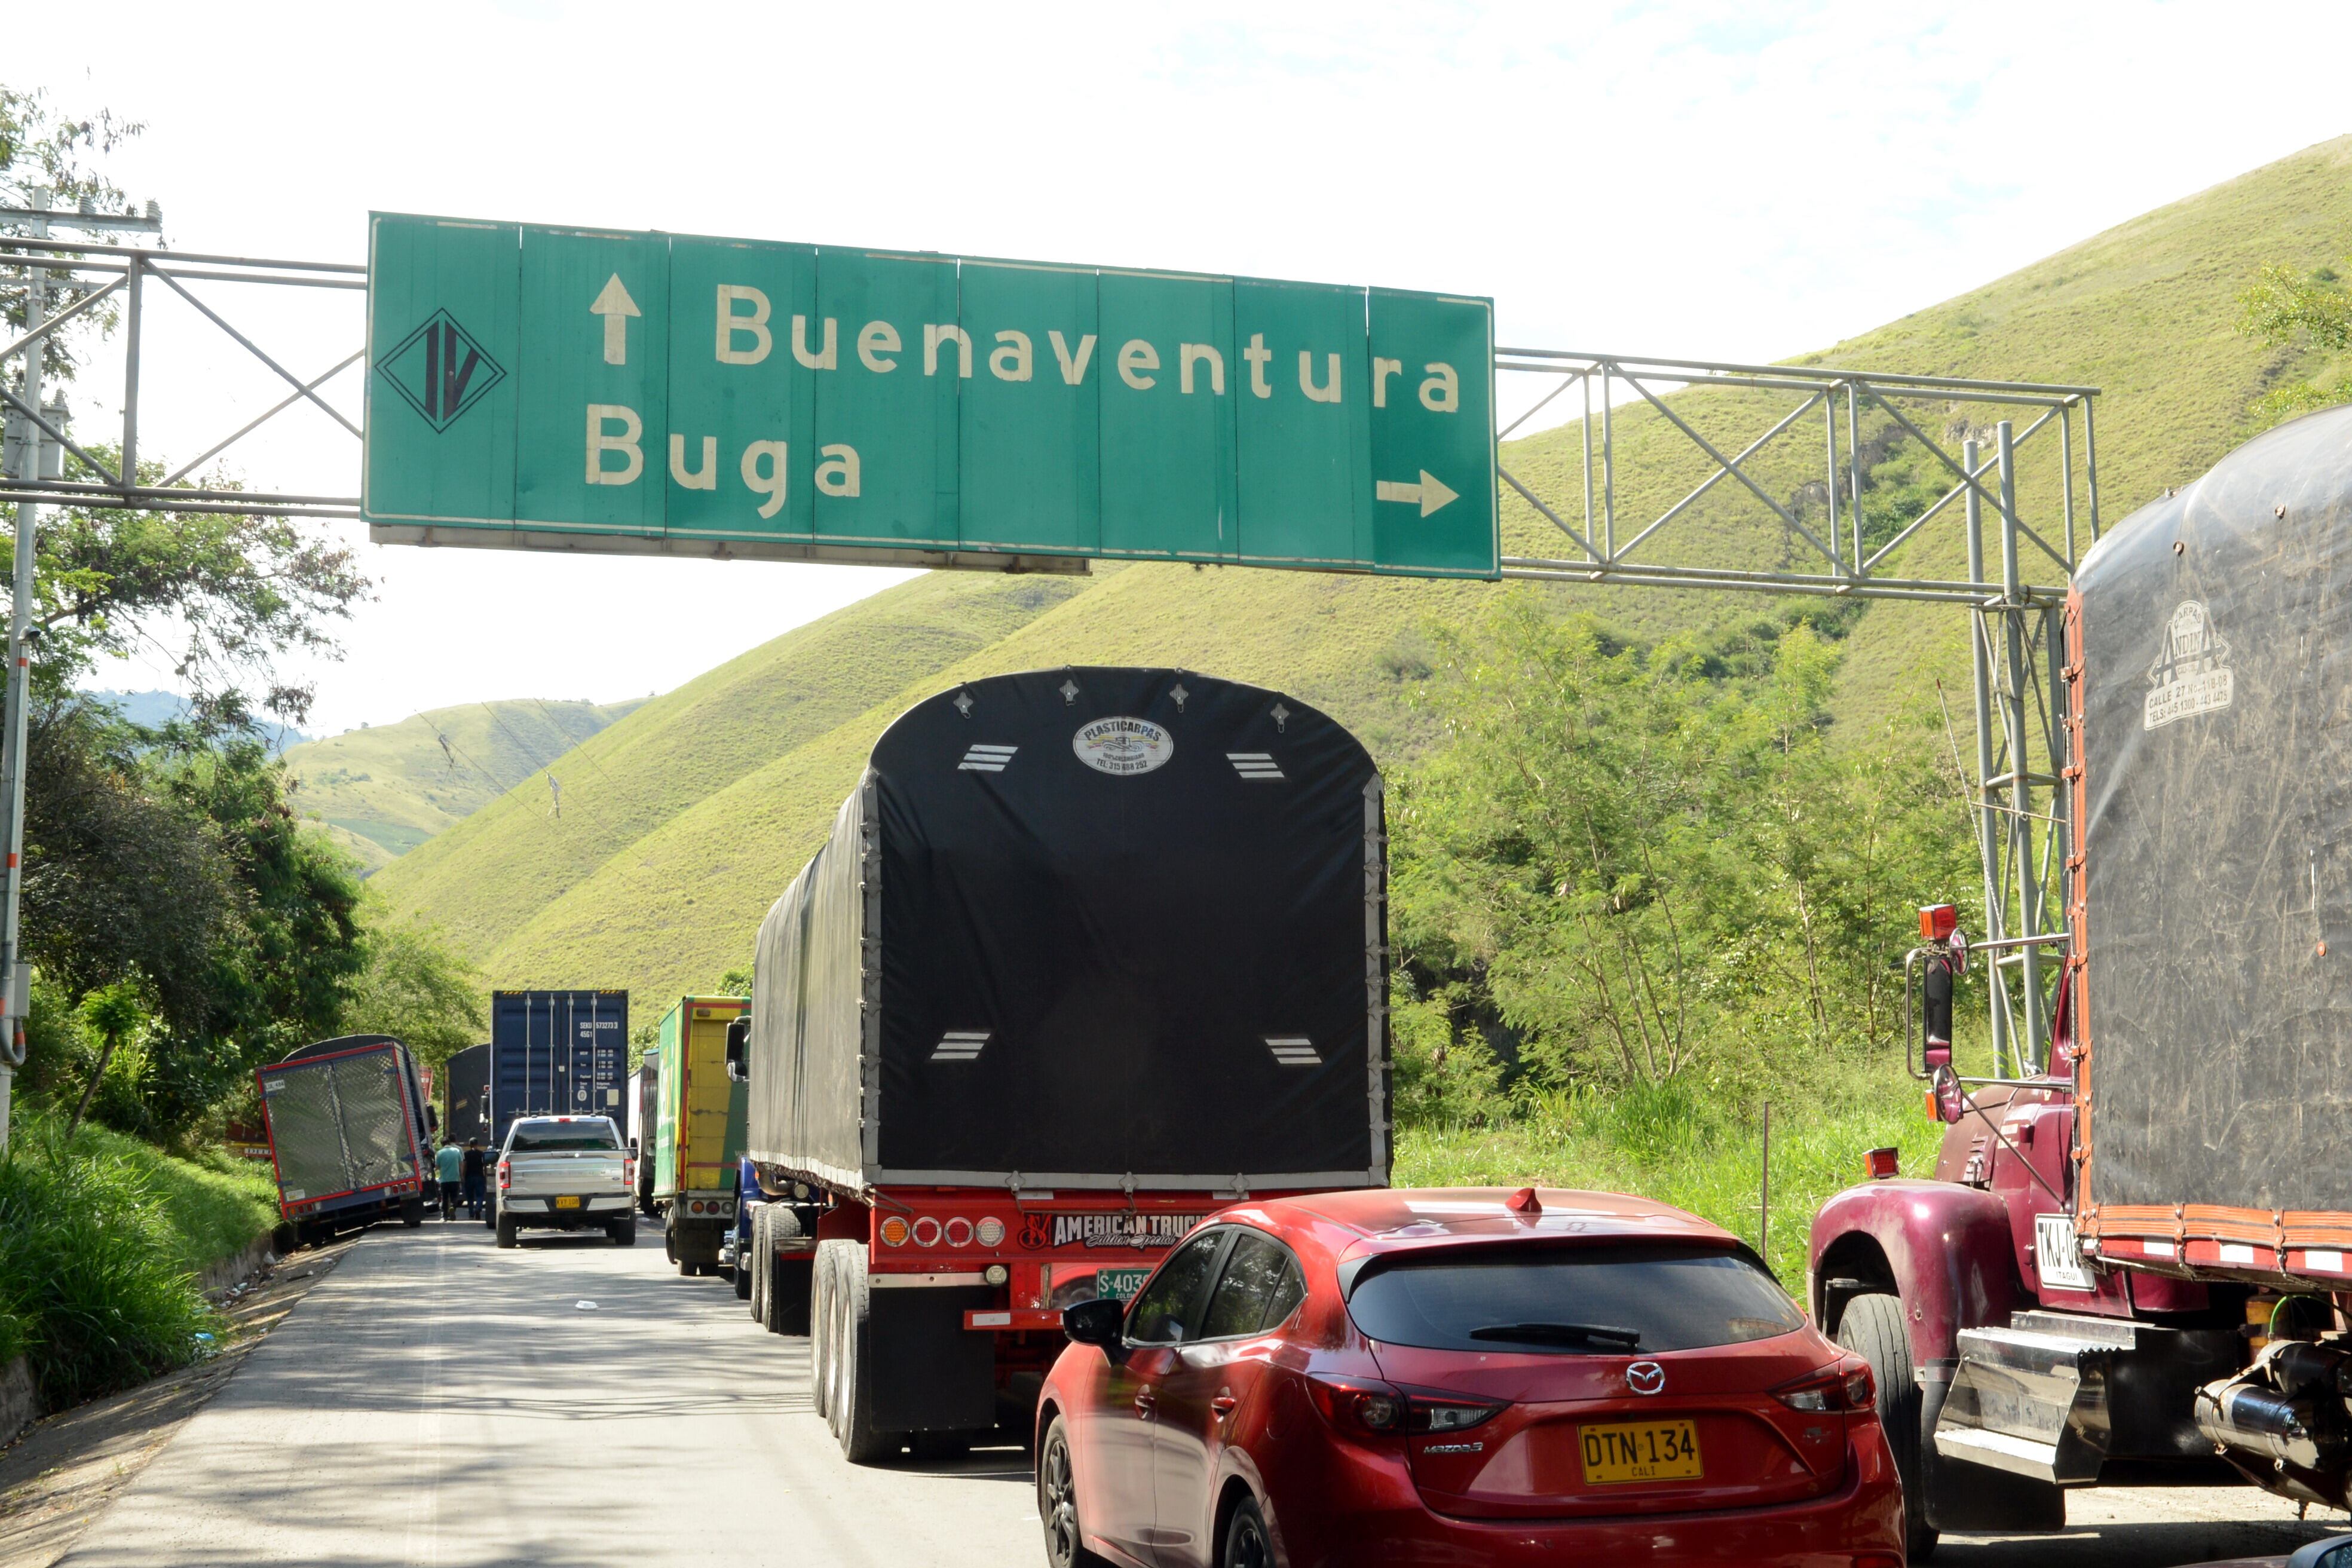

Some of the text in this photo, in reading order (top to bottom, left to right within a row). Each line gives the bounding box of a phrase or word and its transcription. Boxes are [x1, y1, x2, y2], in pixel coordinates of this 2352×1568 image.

[716, 283, 1459, 413] Buenaventura
[585, 404, 860, 519] Buga
[2174, 607, 2201, 629] CARPAS
[2149, 690, 2172, 709] CALLE
[2176, 685, 2185, 698] 27
[2149, 708, 2166, 722] TELS:
[2180, 697, 2195, 711] 1300
[1084, 721, 1162, 742] PLASTICARPAS
[1108, 761, 1121, 771] 315
[1135, 760, 1148, 770] 252
[1054, 1215, 1147, 1247] AMERICAN
[1086, 1232, 1176, 1249] Edition Special
[2056, 1271, 2078, 1281] ITAGUI
[1632, 1465, 1656, 1476] CALI
